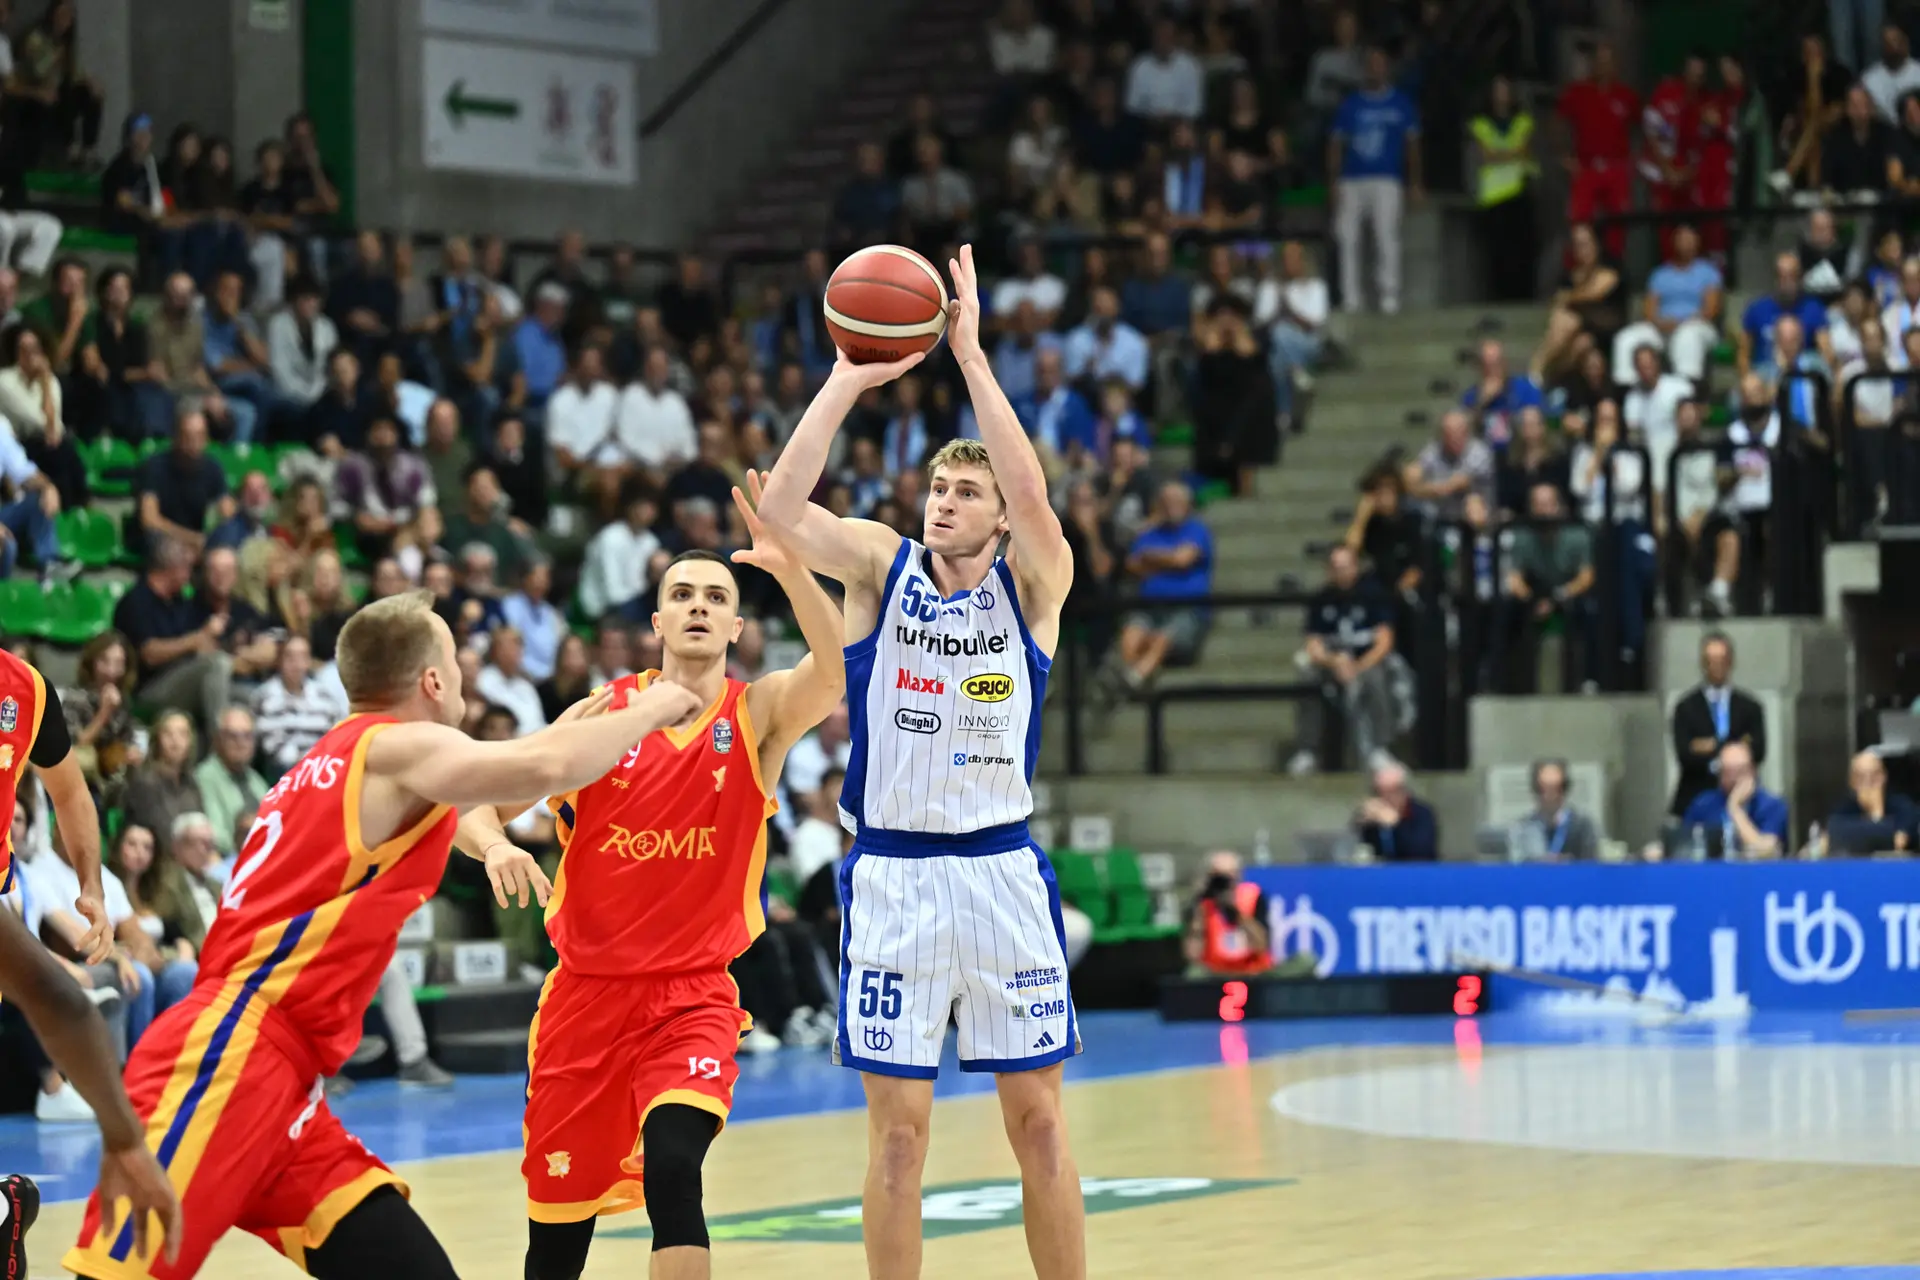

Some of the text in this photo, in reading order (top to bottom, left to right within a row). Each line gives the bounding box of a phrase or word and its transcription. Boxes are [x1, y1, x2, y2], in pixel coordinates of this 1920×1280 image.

[901, 574, 939, 622] 55
[896, 668, 945, 695] Maxi
[966, 679, 1010, 696] CRICH
[968, 754, 1014, 766] db group
[598, 823, 717, 861] ROMA
[1350, 904, 1677, 973] TREVISO BASKET
[1014, 967, 1057, 980] MASTER
[858, 970, 904, 1020] 55
[1030, 999, 1065, 1018] CMB
[1219, 980, 1249, 1022] 2
[1453, 975, 1482, 1016] 2
[688, 1056, 721, 1079] 19
